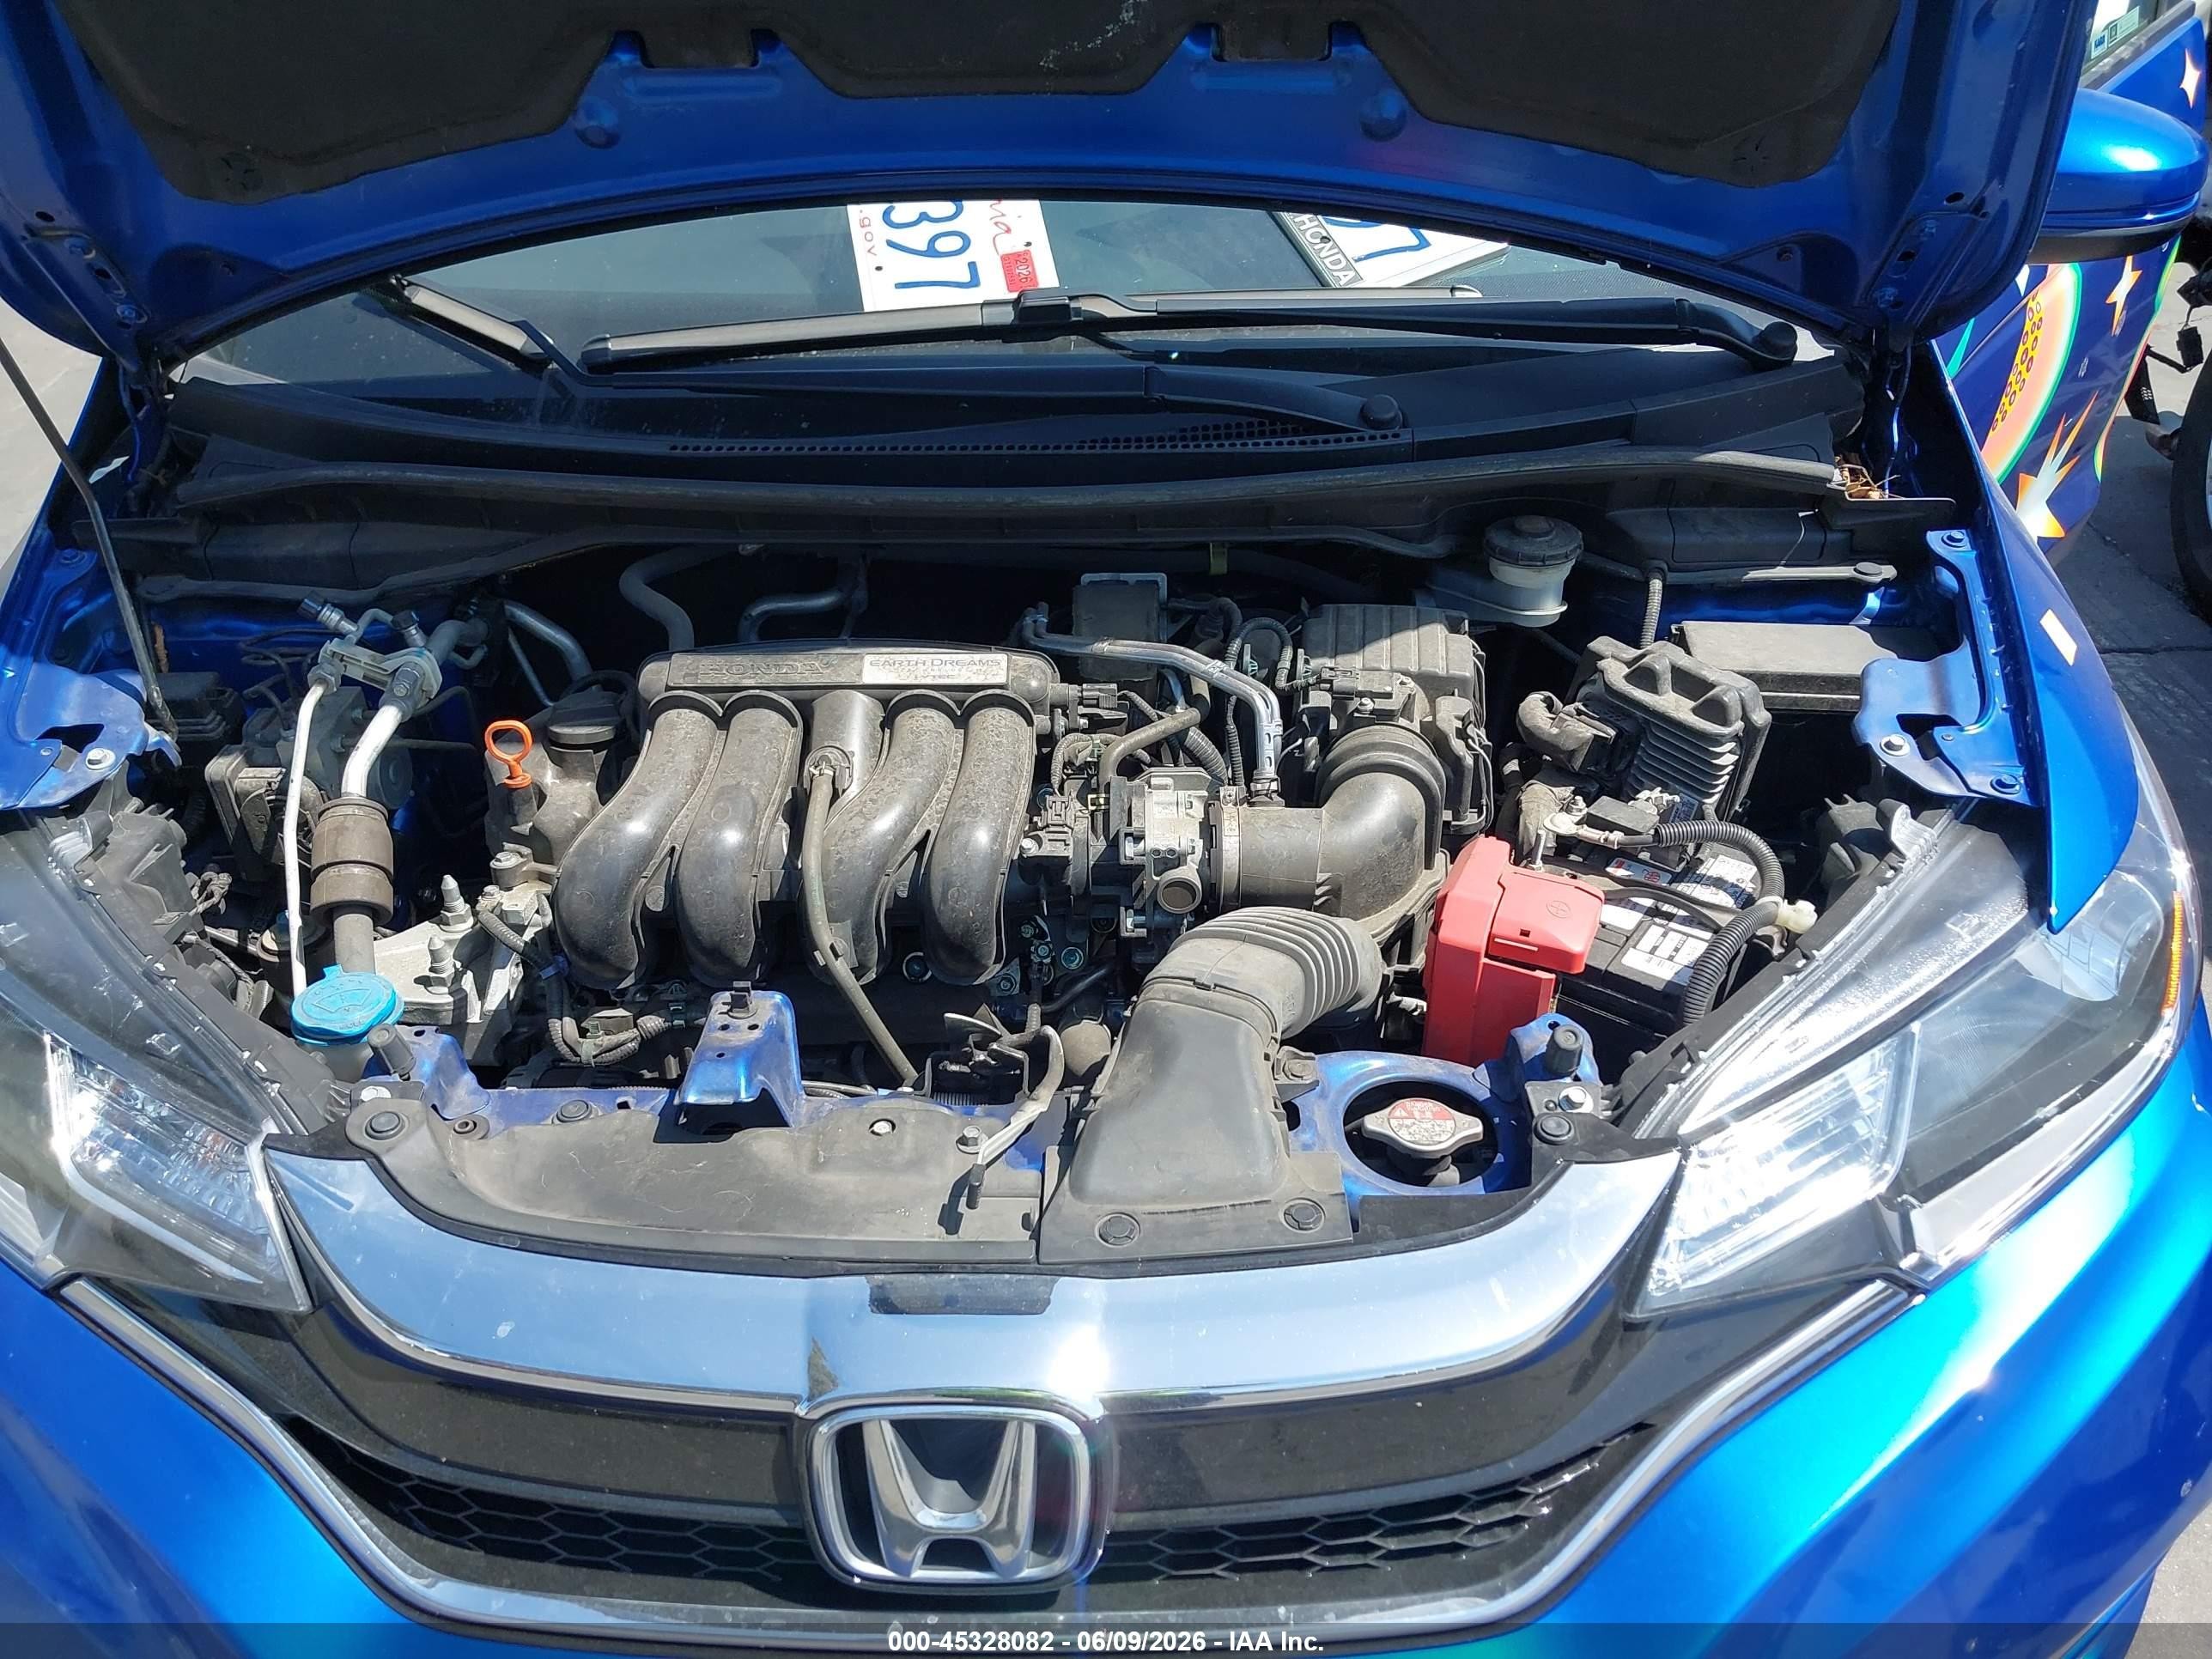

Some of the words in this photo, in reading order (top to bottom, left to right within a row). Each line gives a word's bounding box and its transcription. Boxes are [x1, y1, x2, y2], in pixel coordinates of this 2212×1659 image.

[882, 198, 981, 289] 397
[1295, 214, 1356, 286] HONDA
[1015, 257, 1030, 283] 2026
[700, 662, 825, 676] HONDA
[870, 659, 926, 667] EARTH
[931, 658, 1000, 666] DREAMS
